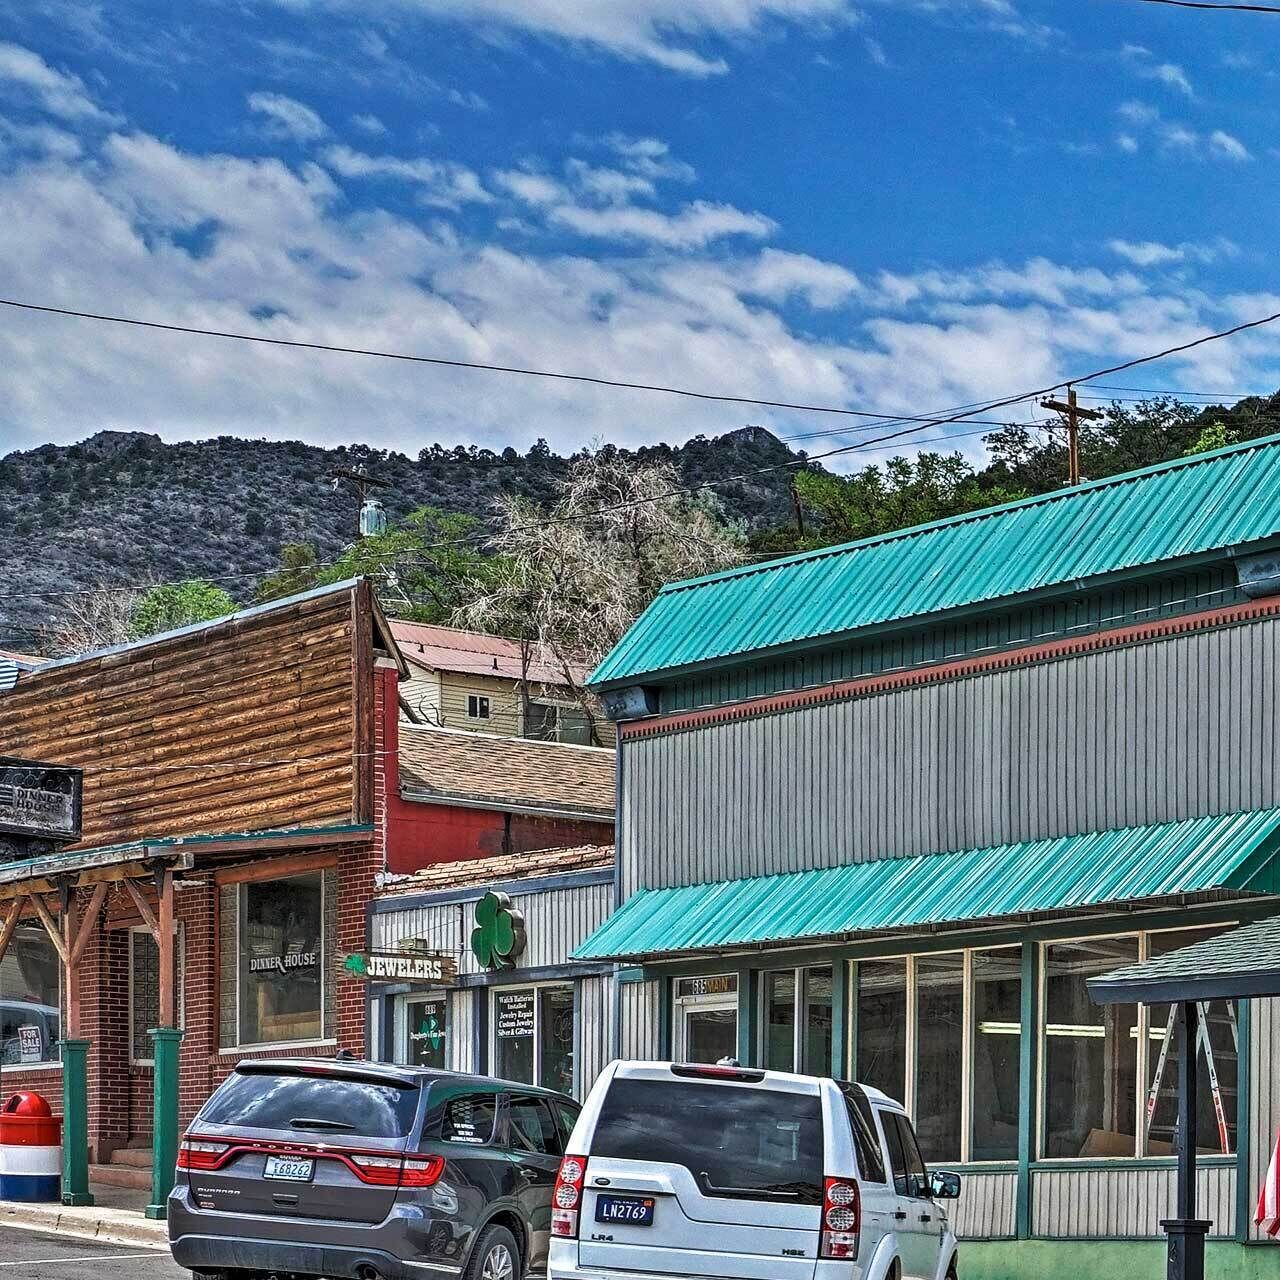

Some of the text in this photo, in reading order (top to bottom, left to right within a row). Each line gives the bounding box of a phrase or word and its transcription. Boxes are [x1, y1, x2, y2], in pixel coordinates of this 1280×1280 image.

[17, 788, 64, 803] DINNER
[250, 952, 316, 974] DINNER HOUSE
[367, 956, 442, 980] JEWELERS
[22, 1030, 37, 1039] FOR
[22, 1038, 40, 1048] SALE
[279, 1163, 310, 1176] 68262
[603, 1203, 647, 1219] LN2769
[591, 1233, 614, 1241] LR4
